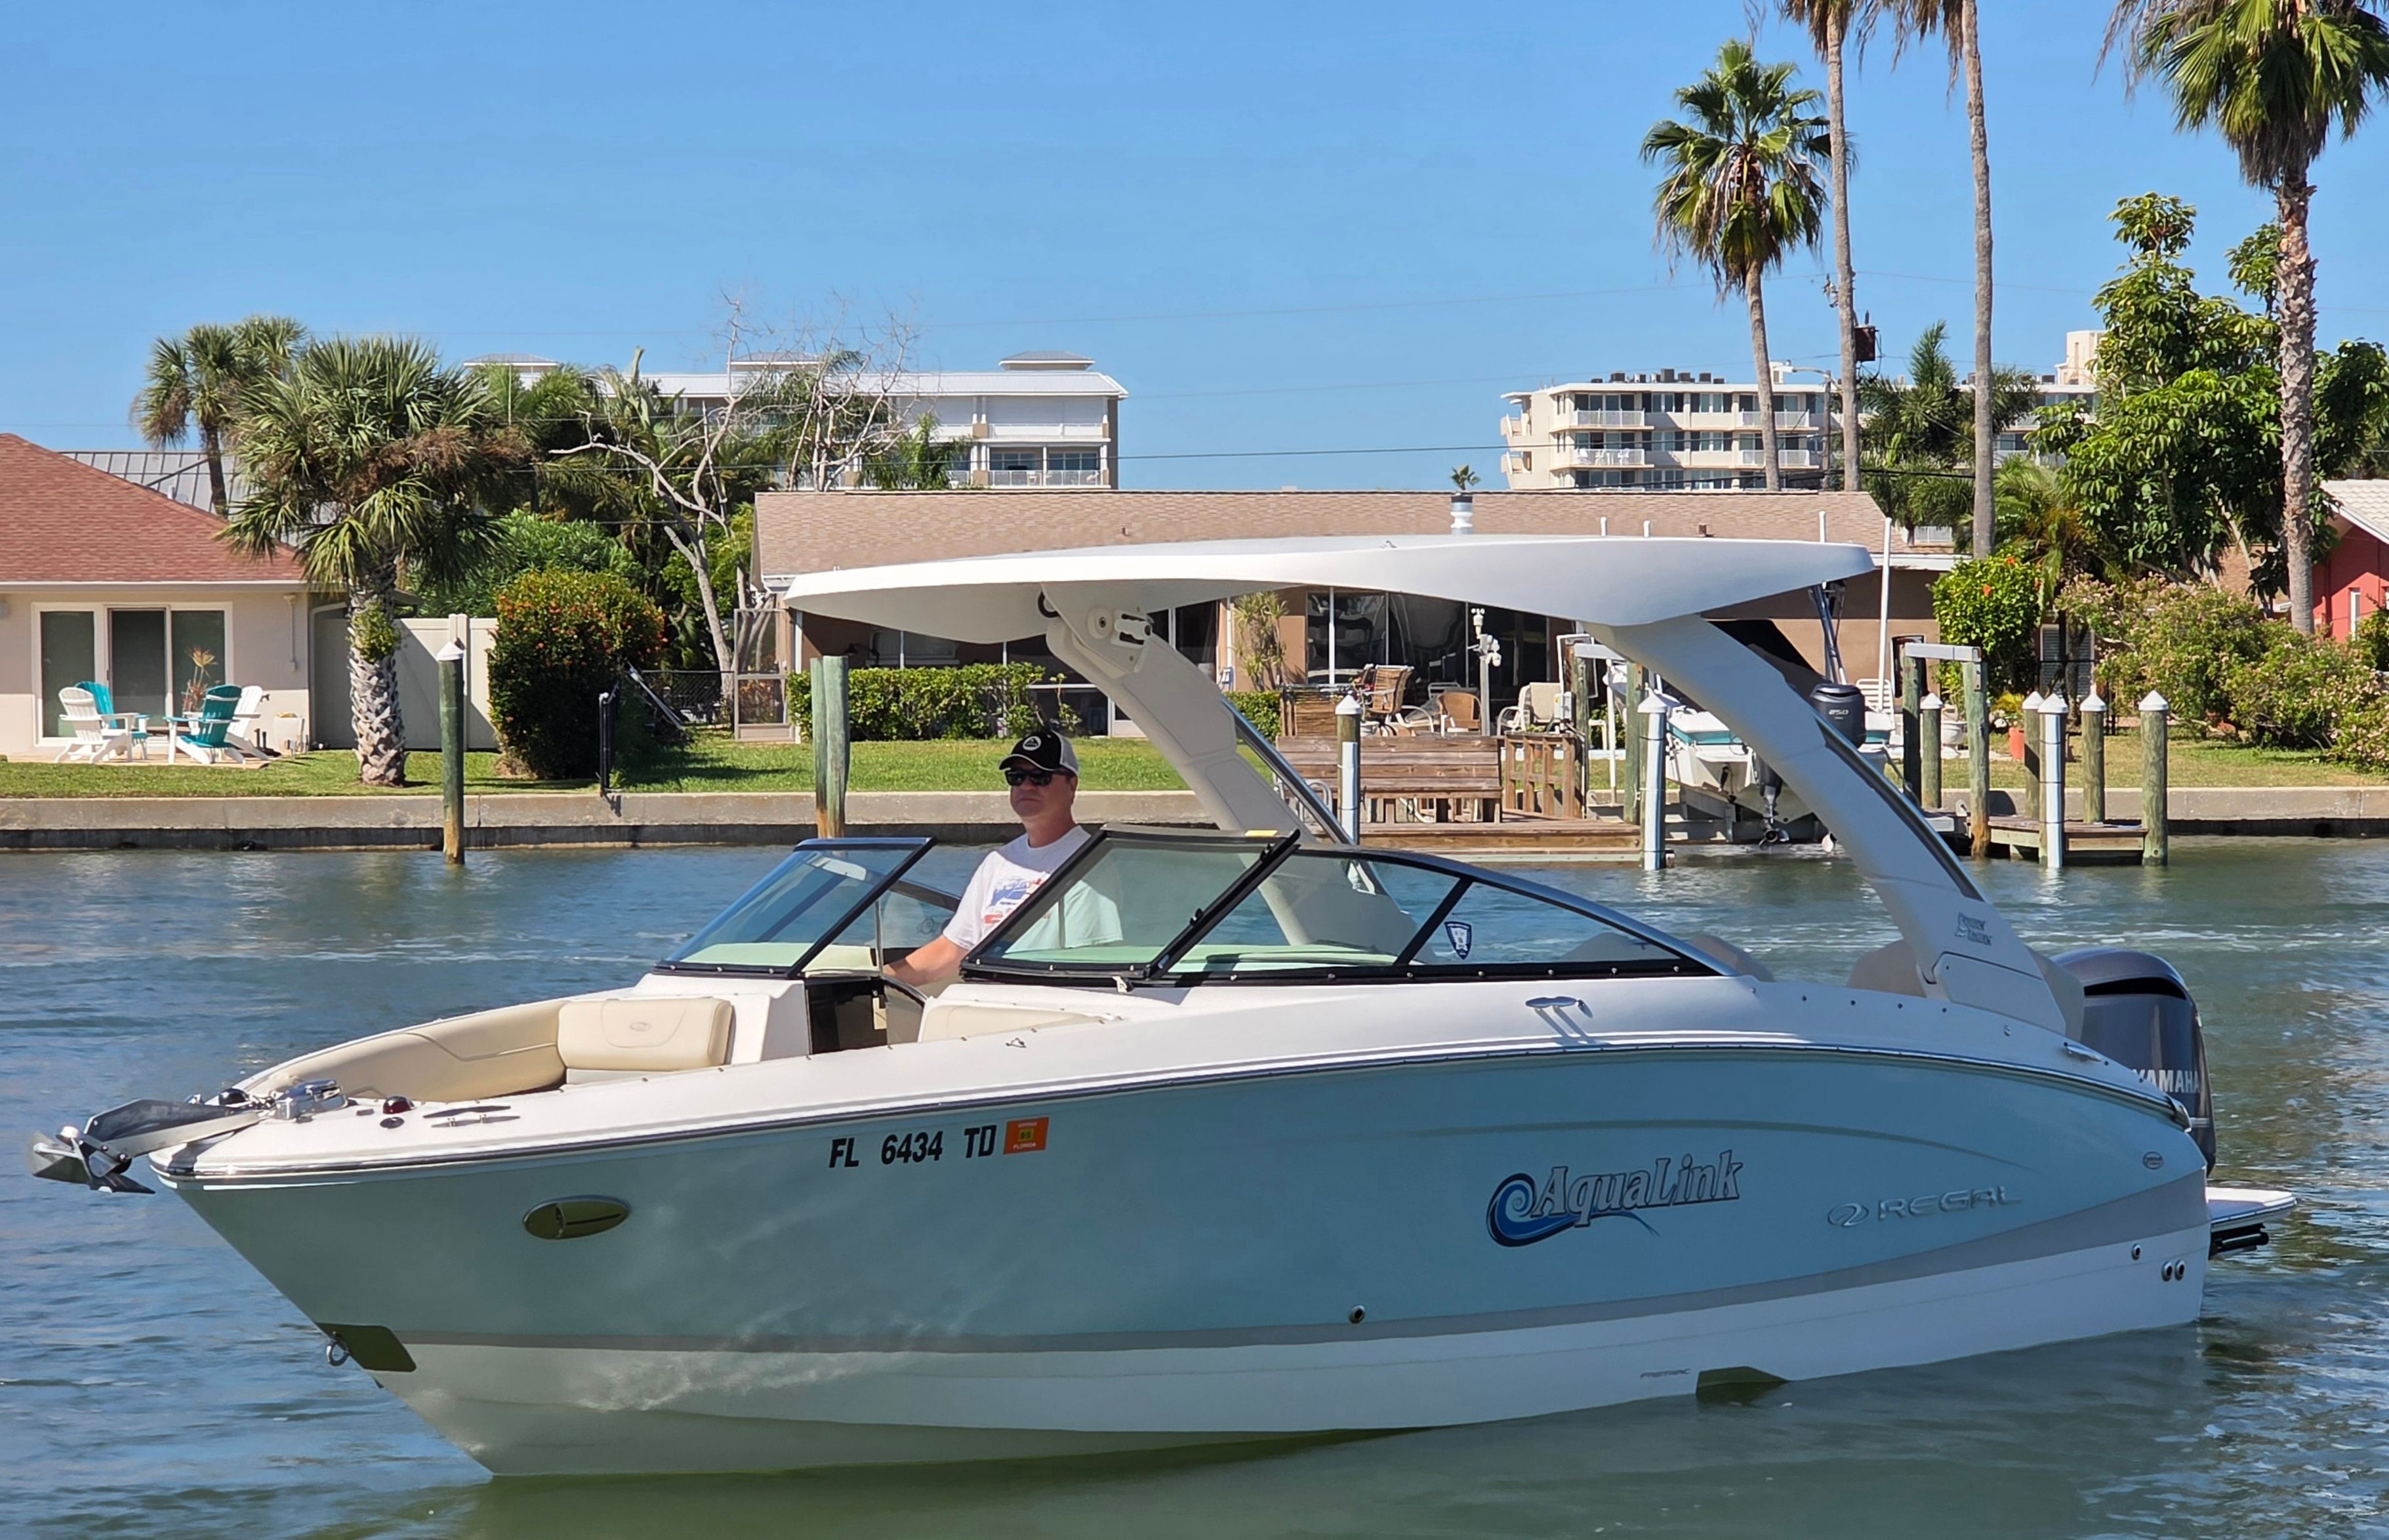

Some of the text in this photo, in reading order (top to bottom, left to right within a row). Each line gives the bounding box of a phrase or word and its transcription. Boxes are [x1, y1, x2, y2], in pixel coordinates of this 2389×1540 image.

[829, 1124, 997, 1168] FL 6434 TD
[1530, 1150, 1744, 1228] AquaLink
[1878, 1186, 2021, 1221] REGAL
